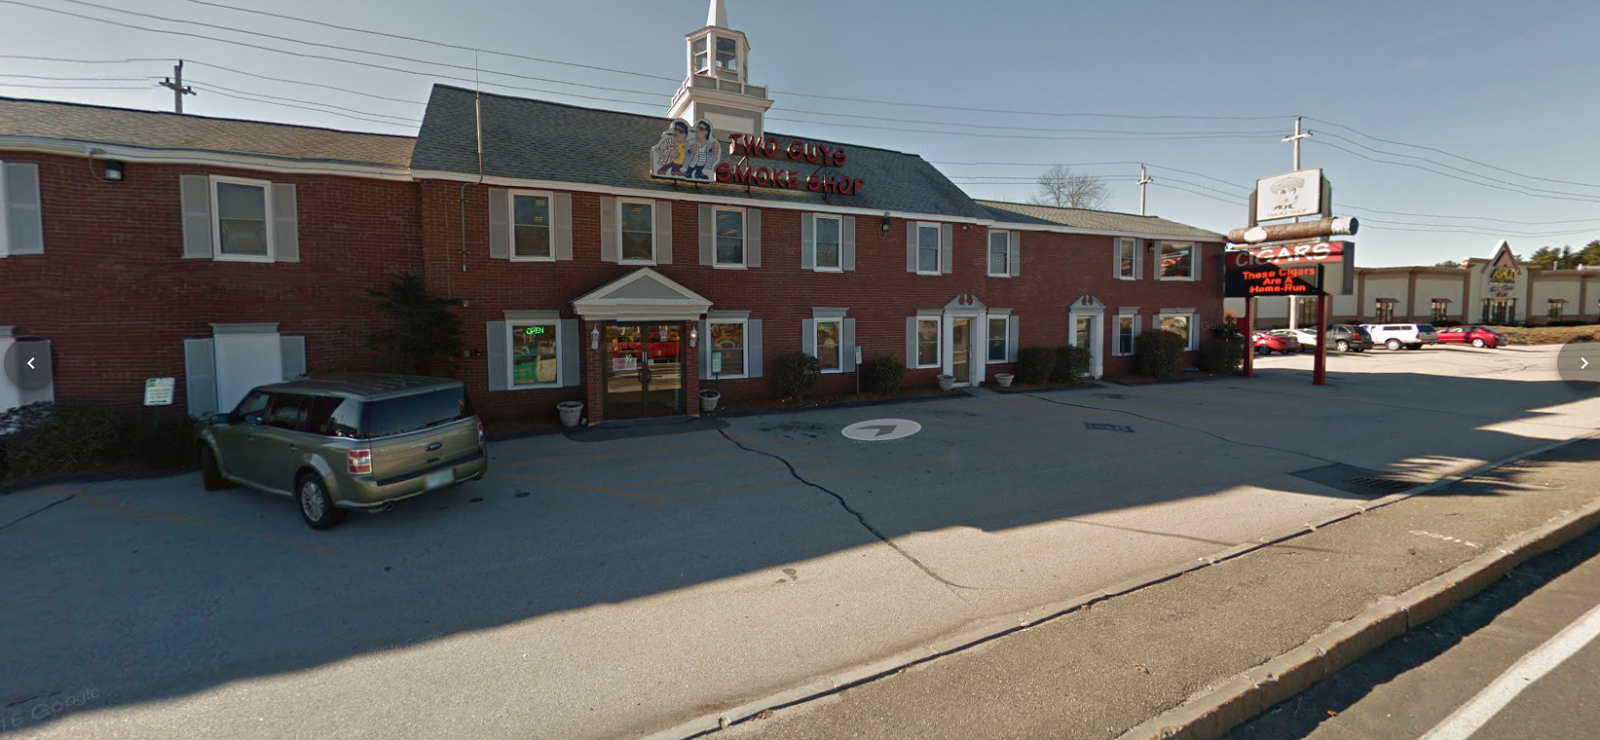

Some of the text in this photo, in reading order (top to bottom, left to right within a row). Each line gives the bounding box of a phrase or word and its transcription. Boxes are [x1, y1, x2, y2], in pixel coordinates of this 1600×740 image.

[728, 133, 847, 168] TWO GUYS
[714, 163, 865, 196] SMOKE SHOP
[1236, 243, 1330, 267] CIGARS
[1242, 268, 1316, 280] These Cigars
[1263, 276, 1293, 286] Are A
[1249, 283, 1306, 293] Home-Run
[525, 327, 545, 336] OPEN
